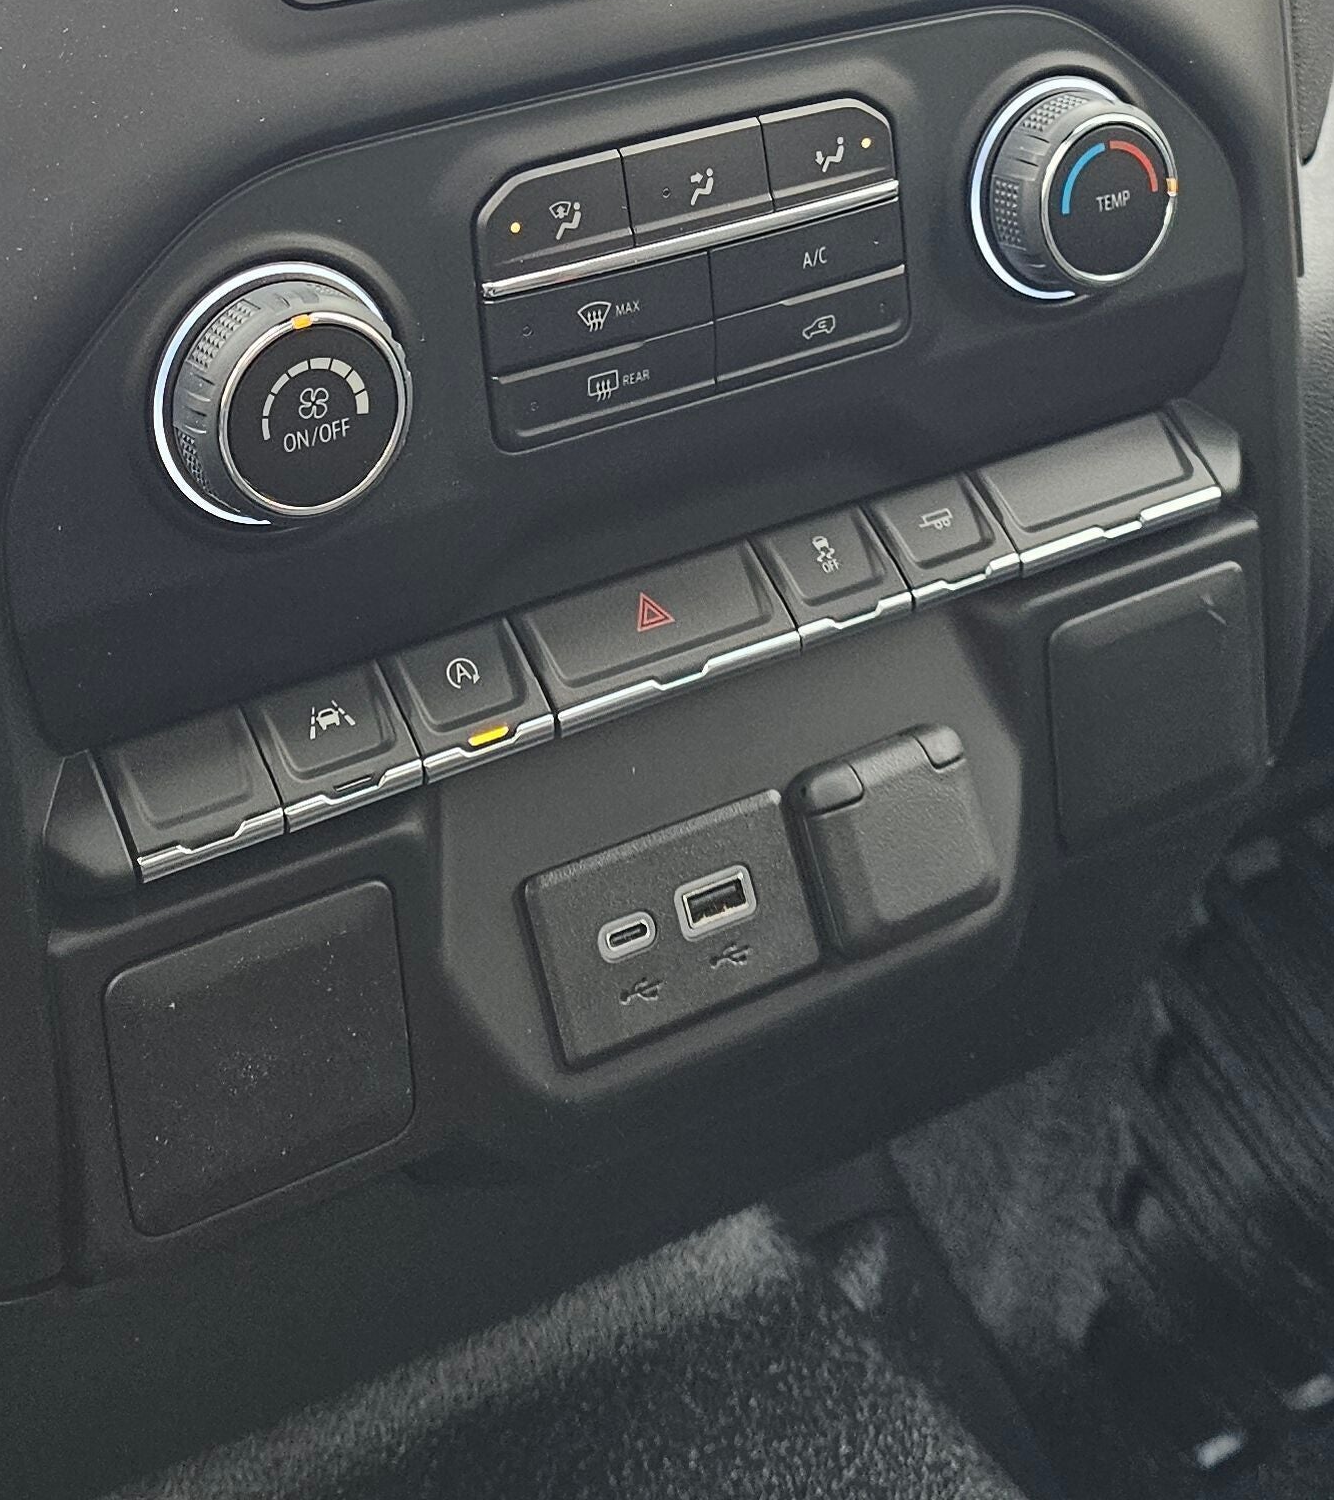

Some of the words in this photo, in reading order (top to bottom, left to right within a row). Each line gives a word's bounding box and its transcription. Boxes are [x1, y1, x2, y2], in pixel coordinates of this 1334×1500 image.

[1095, 190, 1131, 212] TEMP
[802, 246, 827, 269] A/C
[615, 301, 640, 315] MAX
[622, 369, 650, 386] REAR
[283, 417, 351, 453] ON/OFF
